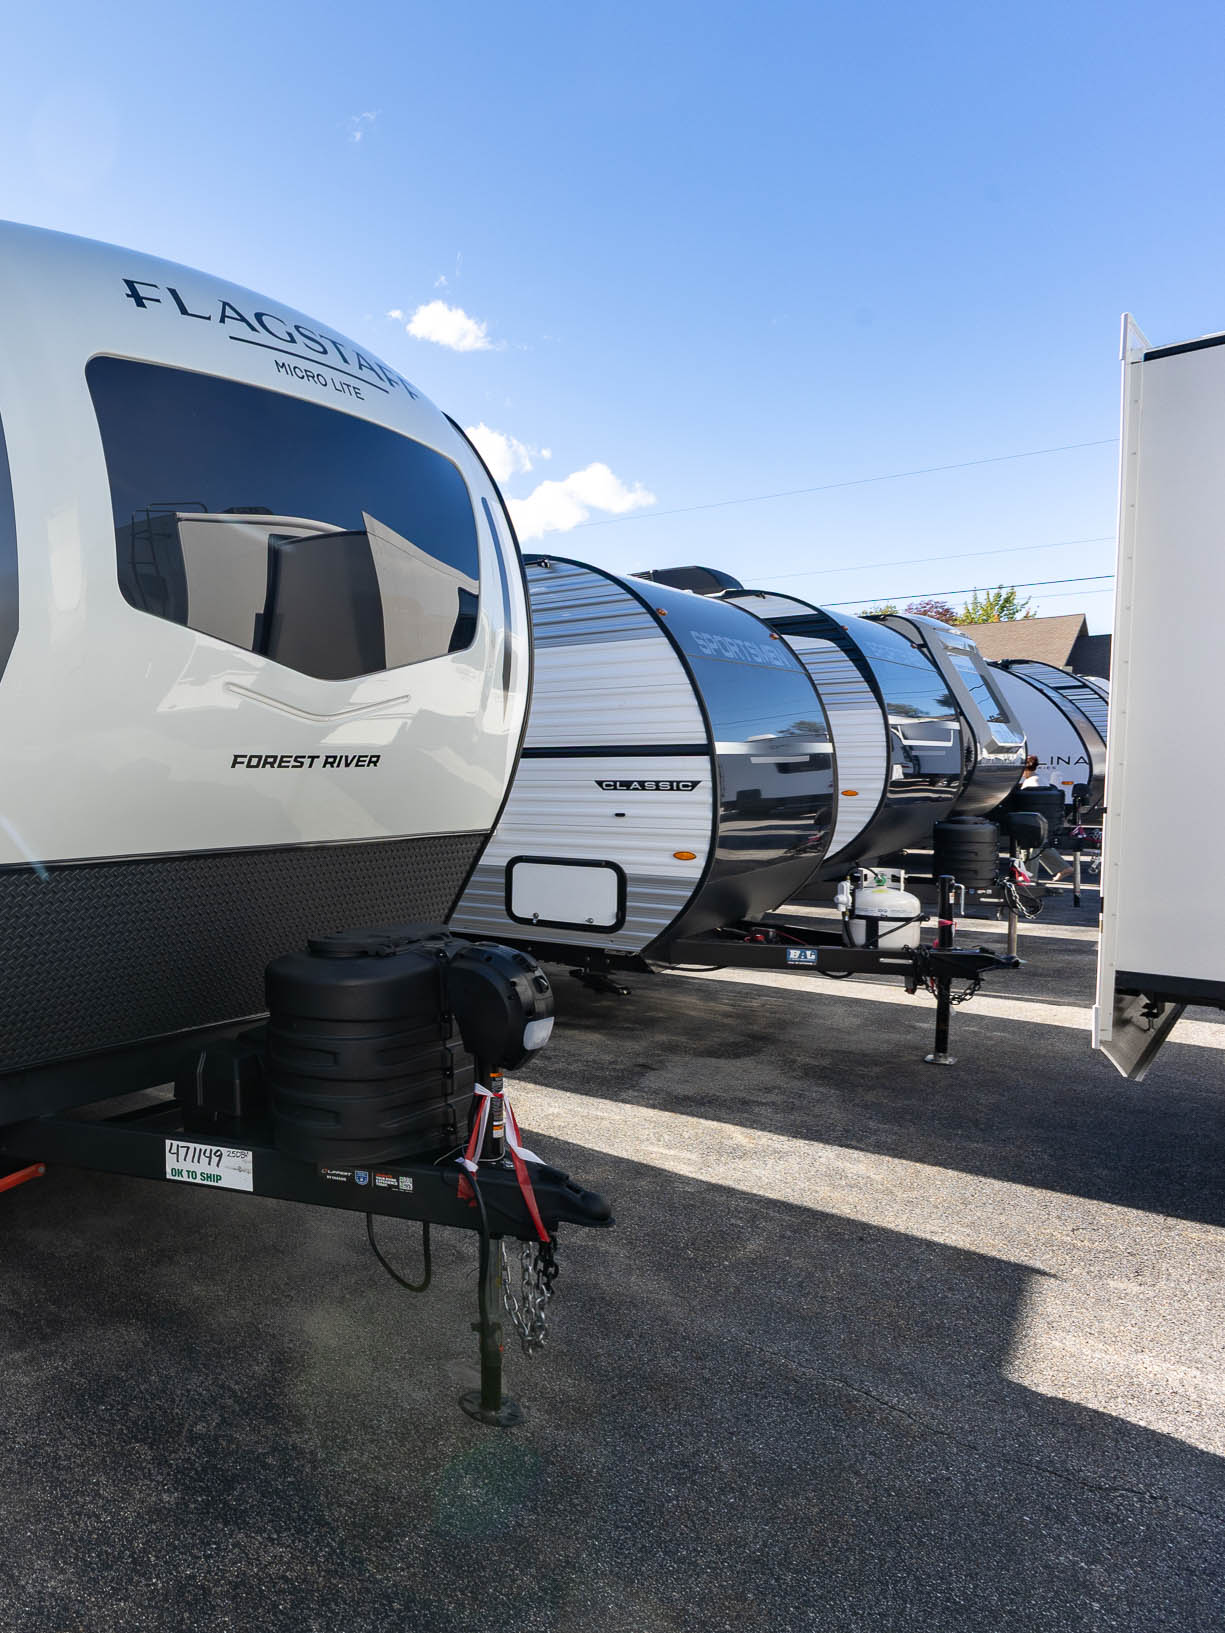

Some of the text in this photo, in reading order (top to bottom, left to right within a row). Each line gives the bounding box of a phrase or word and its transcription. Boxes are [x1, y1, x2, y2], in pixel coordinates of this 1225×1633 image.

[122, 278, 421, 401] FLAGSTAFF
[274, 359, 365, 401] MICRO LITE
[230, 754, 381, 769] FOREST RIVER
[602, 781, 693, 790] CLASSIC
[168, 1142, 224, 1168] 471149
[170, 1168, 223, 1184] OK TO SHIP
